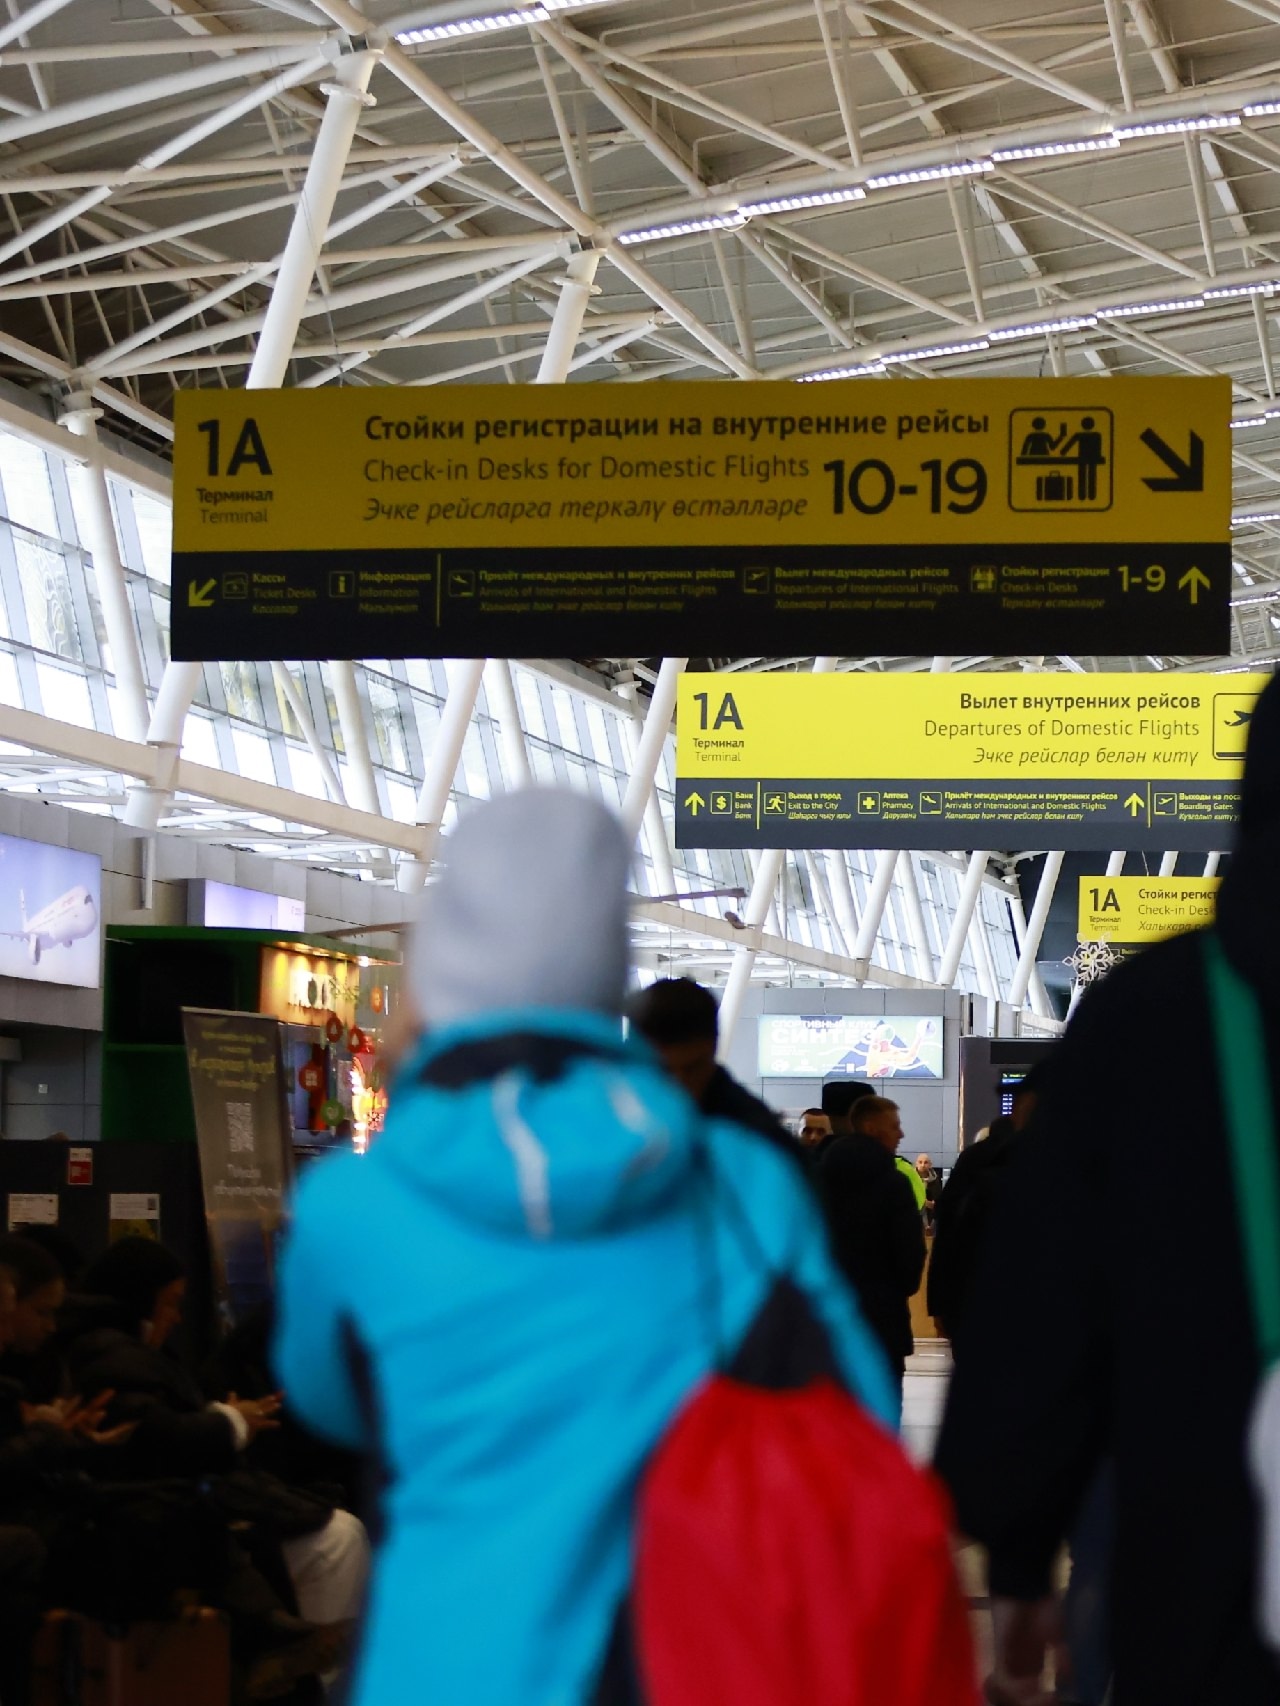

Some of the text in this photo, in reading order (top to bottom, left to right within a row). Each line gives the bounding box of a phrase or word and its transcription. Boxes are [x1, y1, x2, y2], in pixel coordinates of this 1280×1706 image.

[364, 410, 989, 444] Стойки регистрации на внутренние рейсы
[363, 454, 810, 484] Check-in Desks for Domestic Flights
[823, 458, 988, 514] 10-19
[196, 487, 274, 506] Терминал
[200, 508, 268, 524] Terminal
[364, 498, 419, 521] Эчке
[425, 497, 551, 524] рейсларга
[252, 572, 286, 583] Кассы
[359, 570, 432, 583] Информация
[695, 568, 736, 581] рейсов
[775, 566, 949, 580] Вылет международных рейсов
[1002, 566, 1110, 579] Стойки регистрации
[1118, 565, 1166, 593] 1-9
[1048, 582, 1079, 593] Desks
[959, 692, 1201, 713] Вылет внутренних рейсов
[924, 719, 1201, 740] Departures of Domestic Flights
[692, 737, 745, 751] Терминал
[694, 750, 742, 762] Terminal
[972, 747, 1200, 767] Эчке рейслар белән китү
[735, 791, 754, 799] Банк
[788, 791, 813, 801] Выход
[819, 793, 843, 801] город
[883, 792, 909, 800] Аптека
[944, 791, 973, 801] Прилёт
[974, 792, 1038, 802] международных
[1045, 792, 1091, 802] внутренних
[1091, 791, 1119, 801] рейсов
[1178, 792, 1212, 801] Выходы
[734, 801, 753, 809] Bank
[788, 801, 802, 809] Exit
[811, 801, 824, 809] the
[824, 801, 840, 811] City
[882, 801, 914, 811] Pharmacy
[944, 801, 1107, 812] Arrivals of International and Domestic Flights
[1178, 802, 1234, 812] Boarding Gates
[1138, 888, 1217, 902] Стойки регист
[1138, 904, 1185, 916] Check-in
[1089, 915, 1121, 924] Терминал
[1091, 923, 1119, 932] Terminal
